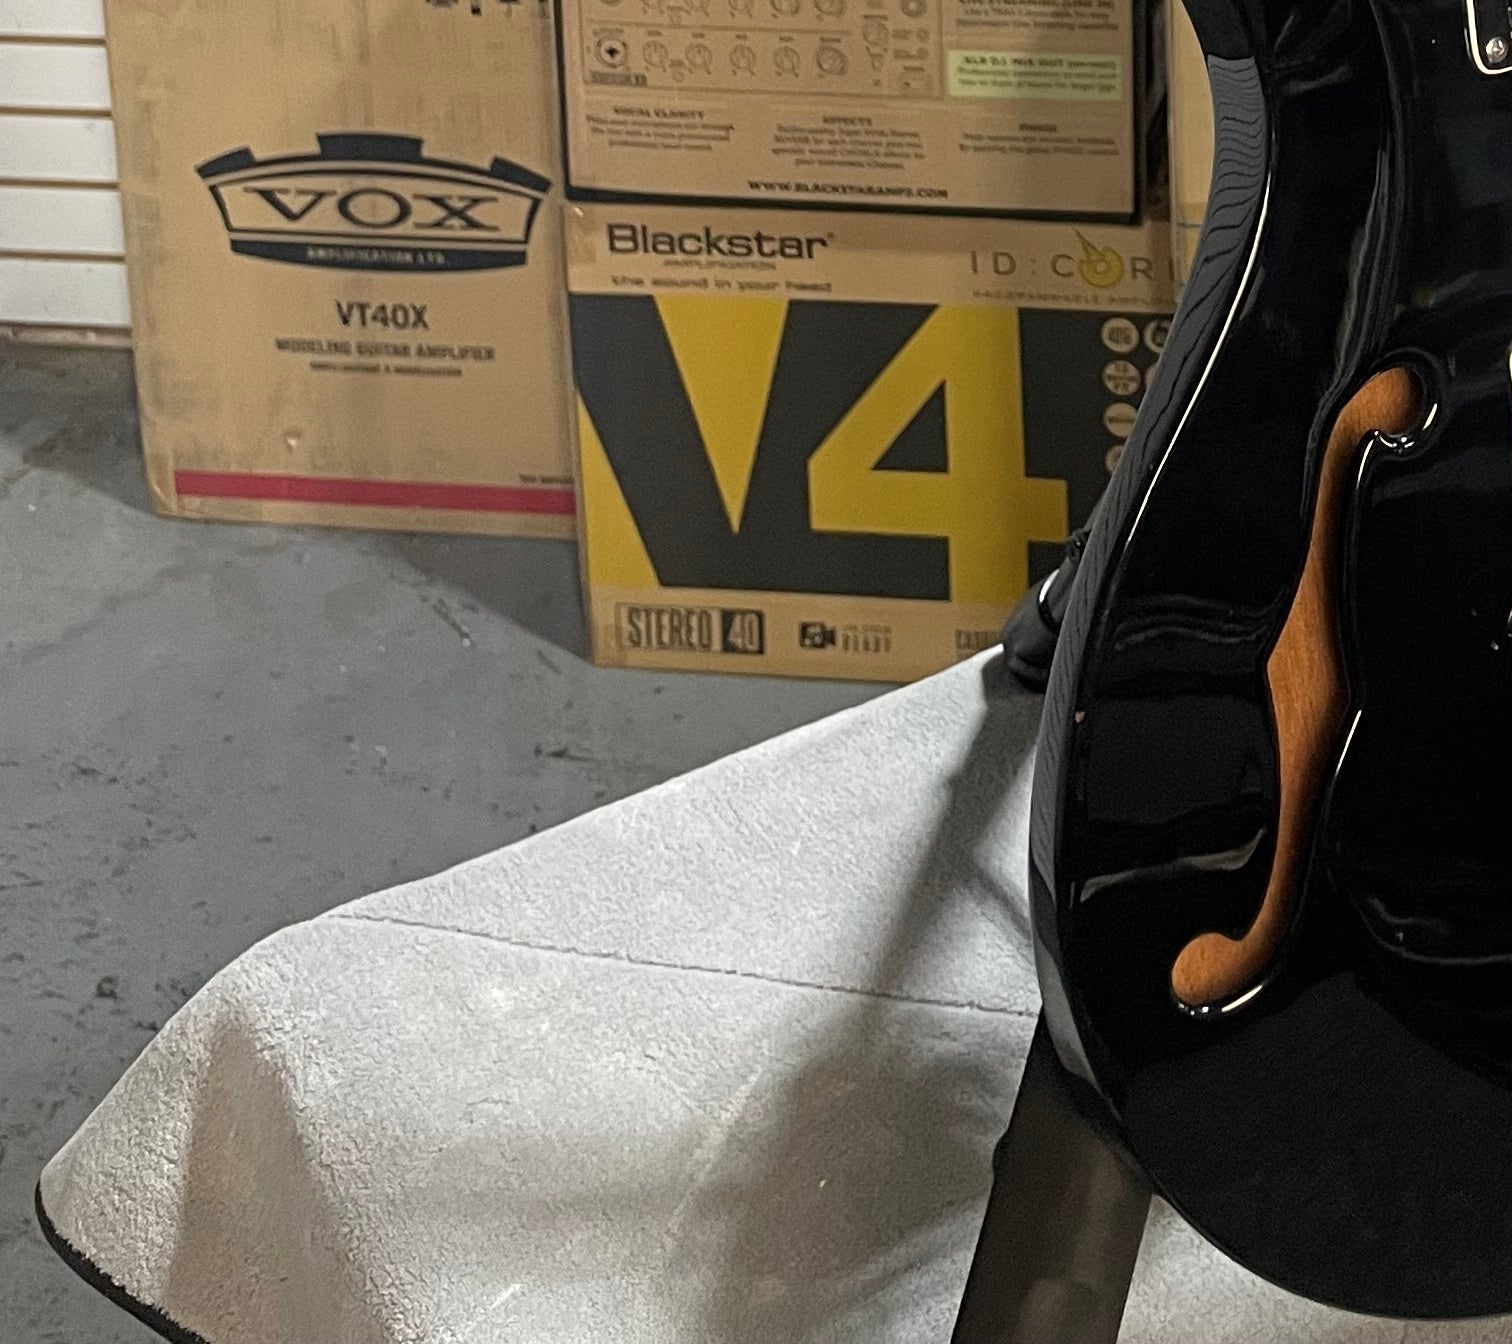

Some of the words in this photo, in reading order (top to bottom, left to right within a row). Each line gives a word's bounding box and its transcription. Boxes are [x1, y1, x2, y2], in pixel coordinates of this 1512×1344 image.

[243, 187, 501, 232] VOX
[606, 221, 829, 260] Blackstar
[334, 299, 430, 330] VT40X
[568, 292, 1068, 610] V4
[627, 606, 714, 650] STEREO
[728, 612, 761, 650] 40
